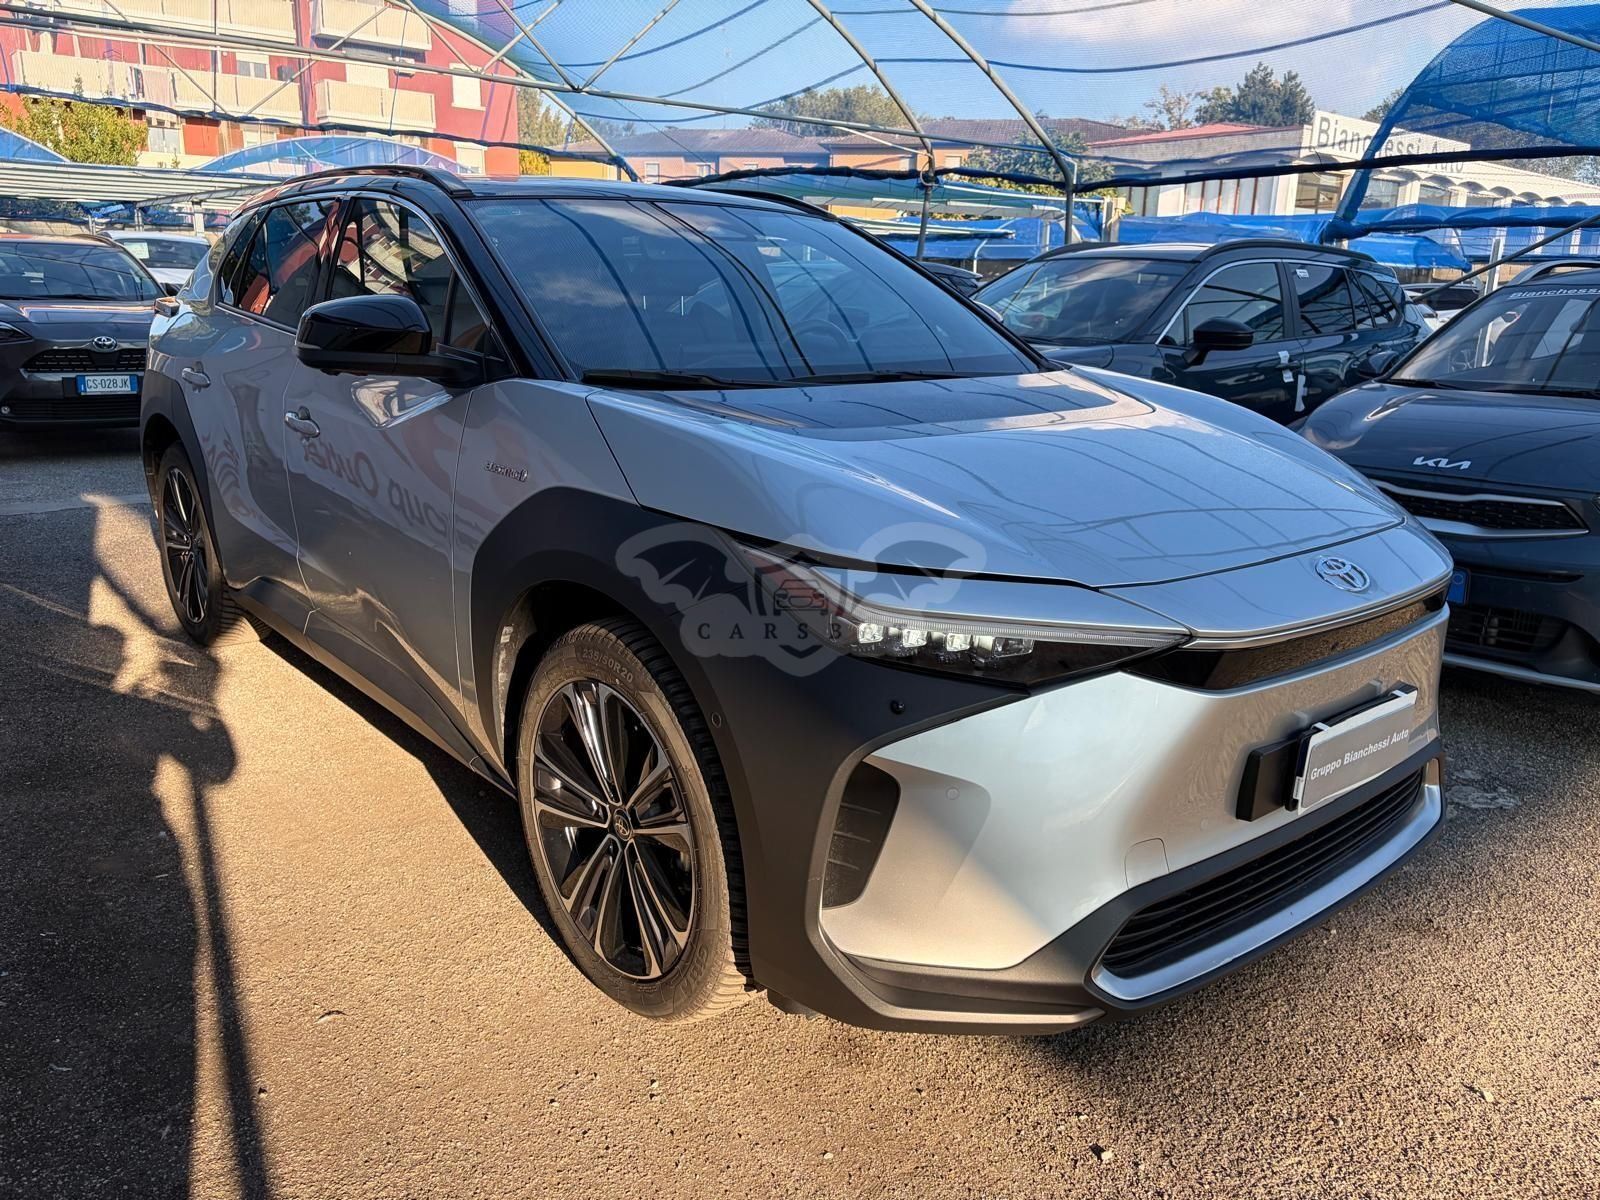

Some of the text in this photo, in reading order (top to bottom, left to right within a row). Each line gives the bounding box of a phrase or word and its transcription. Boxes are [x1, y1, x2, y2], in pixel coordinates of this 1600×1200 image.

[1317, 116, 1422, 156] Biancessi
[1413, 456, 1472, 470] KIA
[581, 649, 634, 684] 235/50R20
[1310, 728, 1409, 781] Gruppo Bianchessi Auto
